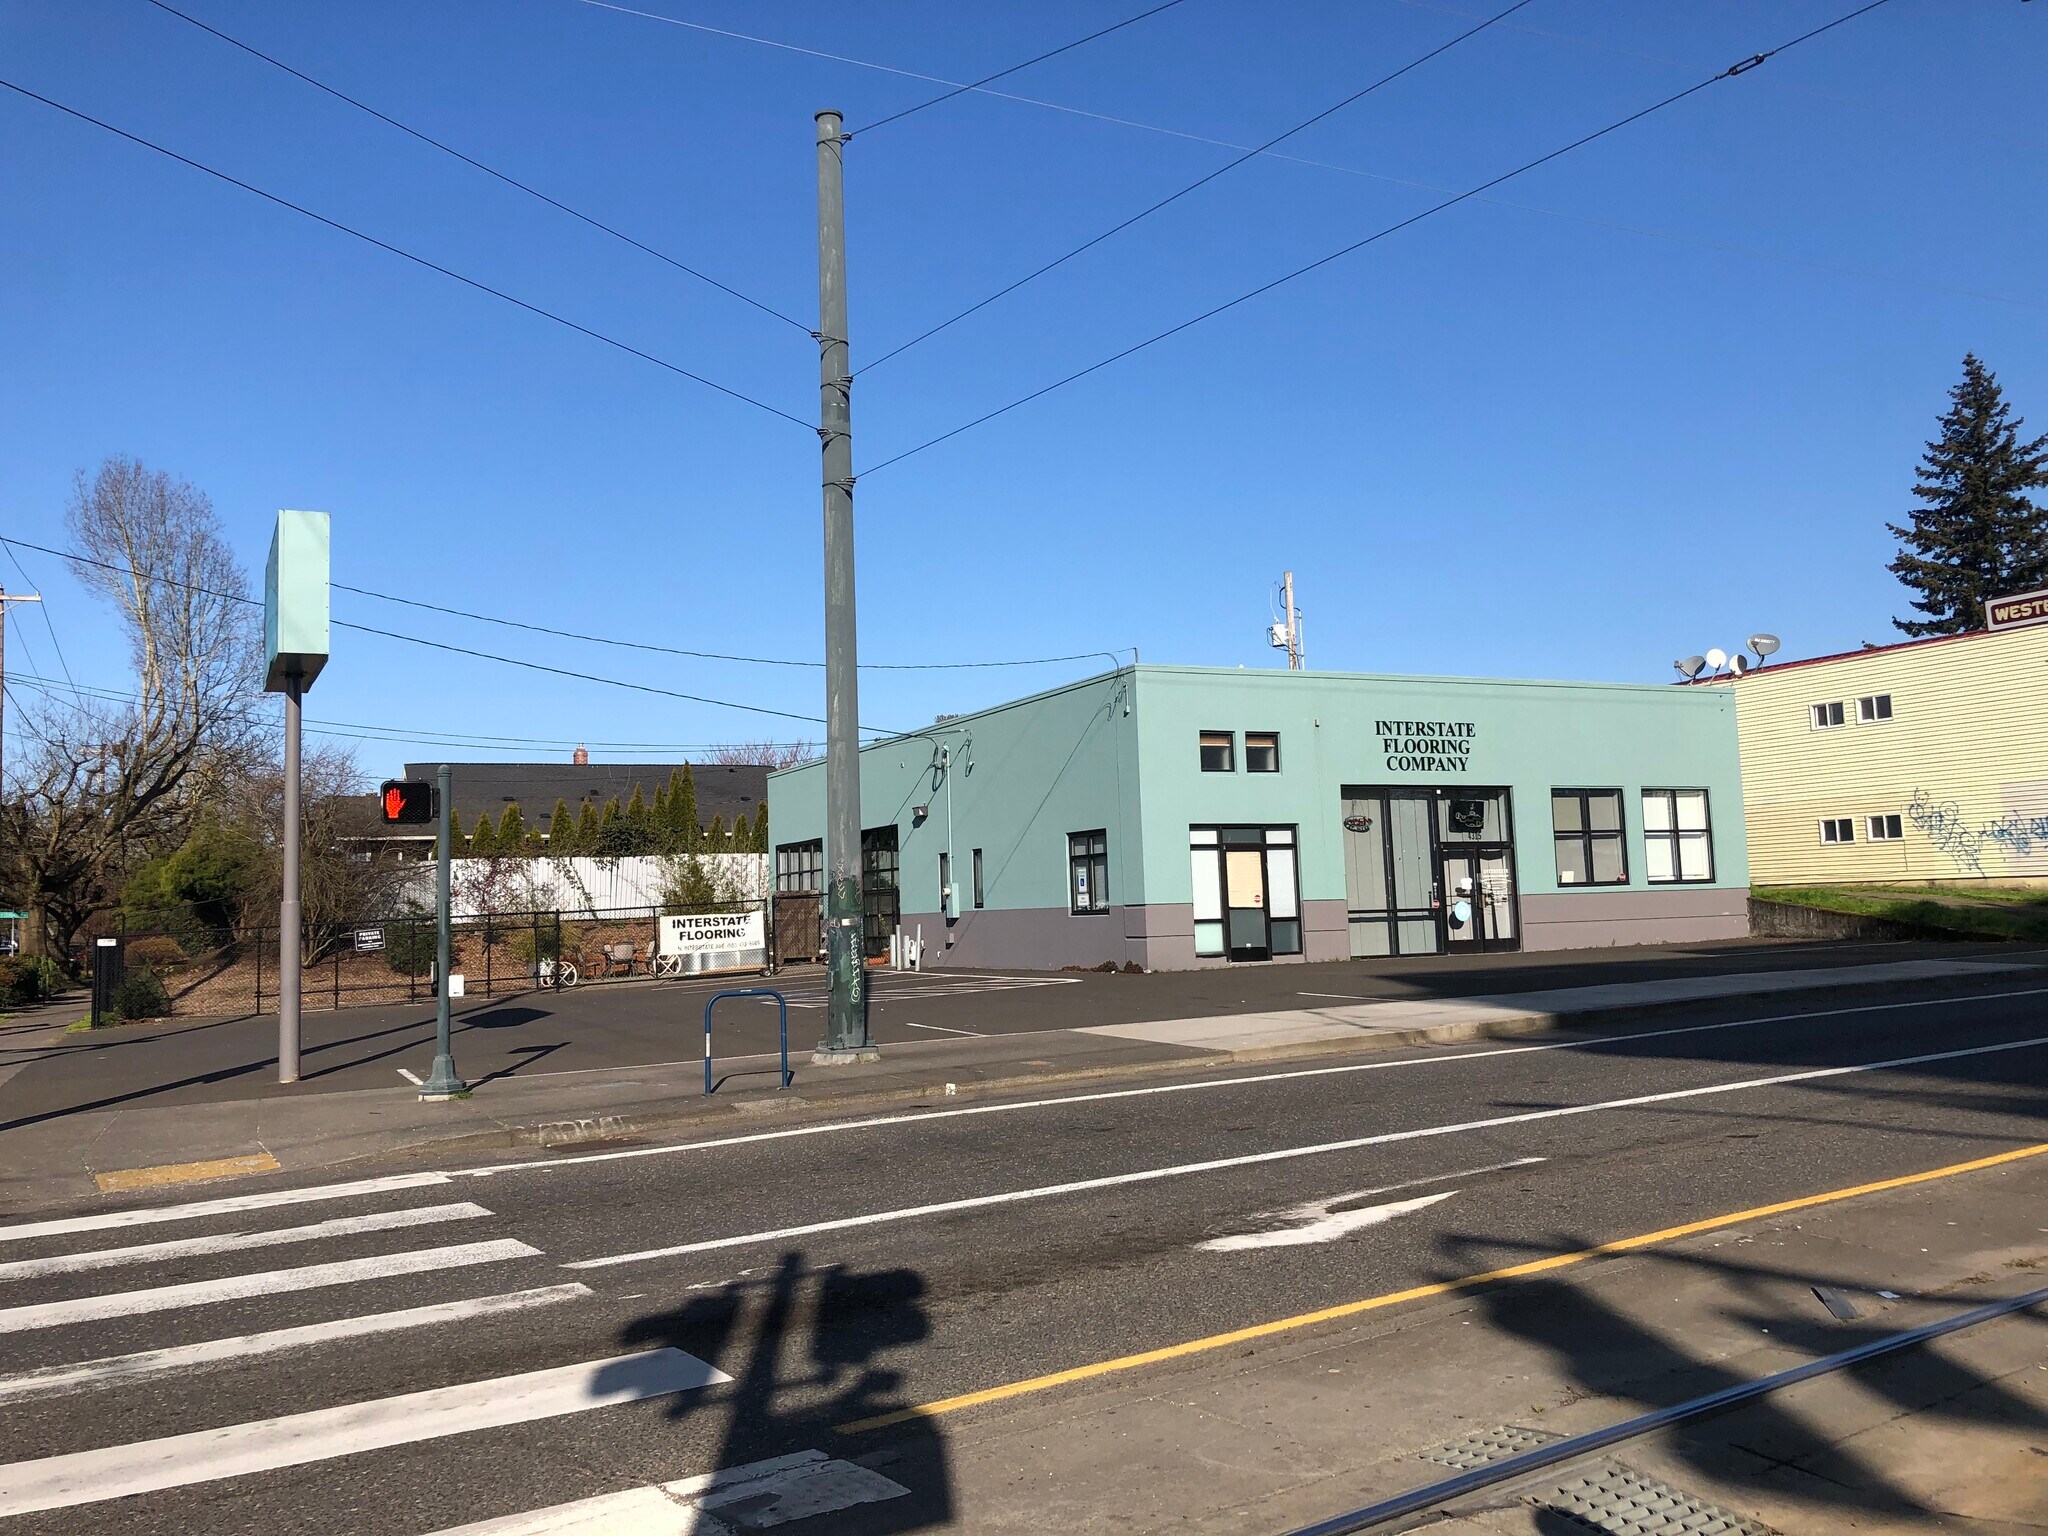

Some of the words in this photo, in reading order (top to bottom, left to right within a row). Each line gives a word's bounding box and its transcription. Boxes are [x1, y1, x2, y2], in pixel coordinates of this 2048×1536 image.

[1374, 720, 1476, 737] INTERSTATE
[1382, 738, 1471, 754] FLOORING
[1386, 756, 1469, 772] COMPANY
[672, 915, 751, 929] INTERSTATE
[679, 928, 746, 941] FLOORING
